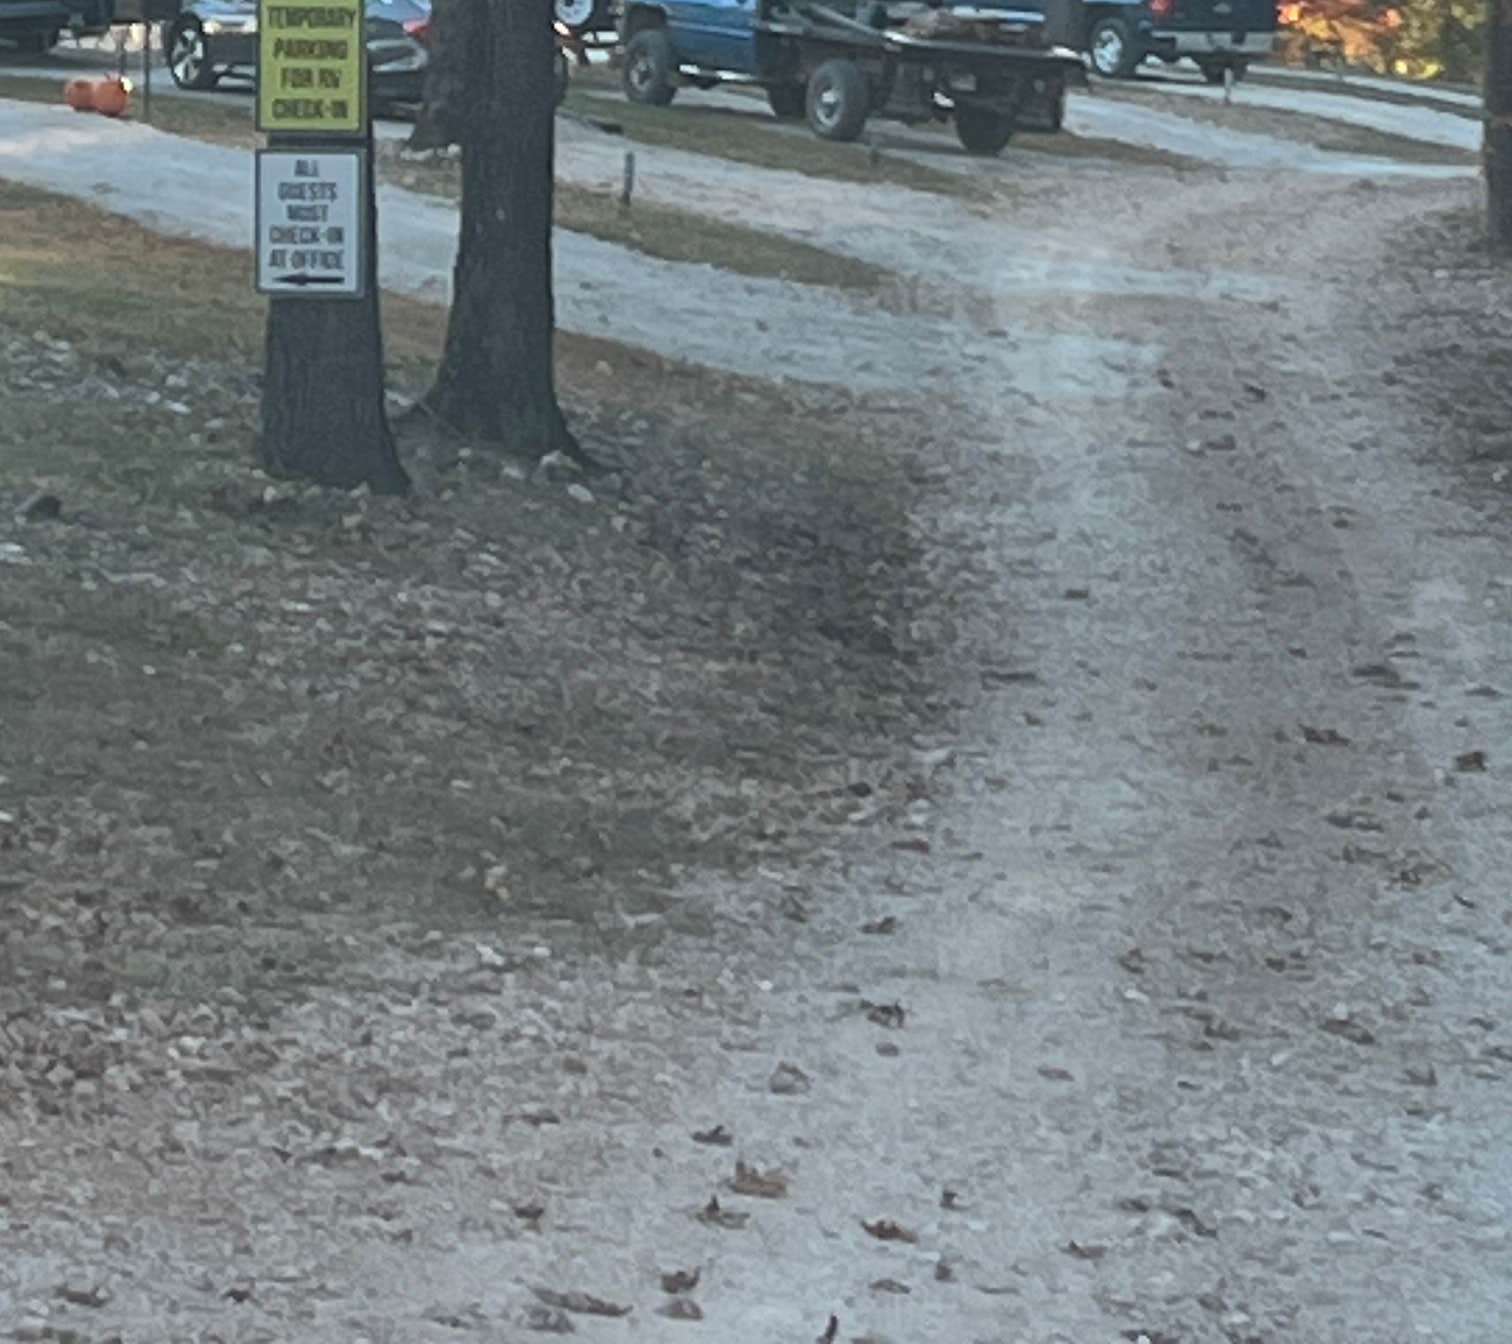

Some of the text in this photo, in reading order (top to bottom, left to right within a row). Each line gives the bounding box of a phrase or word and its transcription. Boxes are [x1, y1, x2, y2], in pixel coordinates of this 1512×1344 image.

[267, 6, 356, 29] TEMPORARY
[272, 38, 348, 60] PARKING
[280, 68, 342, 89] FOR RV
[272, 99, 349, 120] CHECK-IN
[278, 182, 338, 202] GUESTS
[269, 224, 344, 244] CHECK-IN
[290, 249, 345, 269] OFFICE
